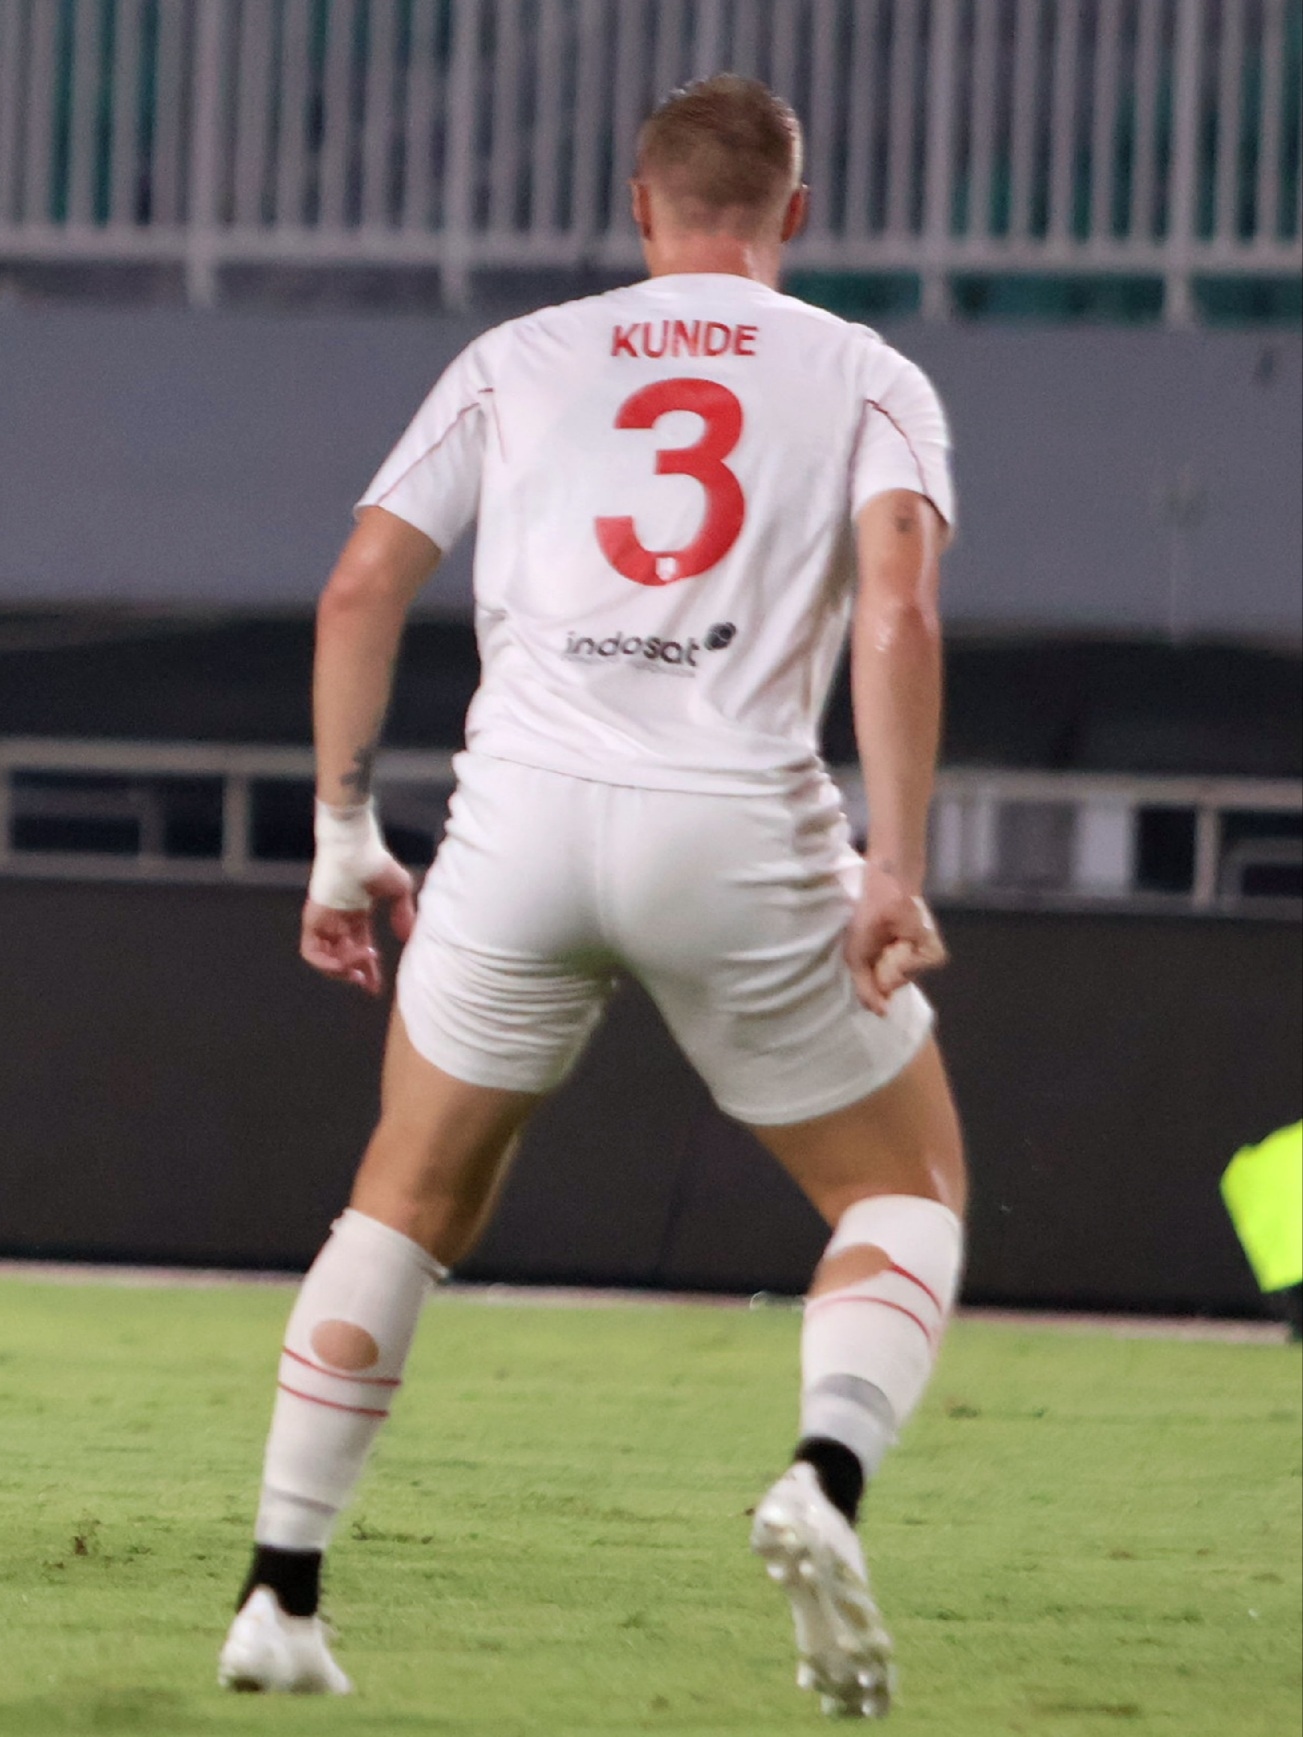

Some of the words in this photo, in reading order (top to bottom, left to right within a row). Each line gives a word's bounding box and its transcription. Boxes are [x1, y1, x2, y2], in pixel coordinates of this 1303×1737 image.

[611, 320, 758, 357] KUNDE
[593, 377, 746, 587] 3
[567, 630, 700, 667] indosat
